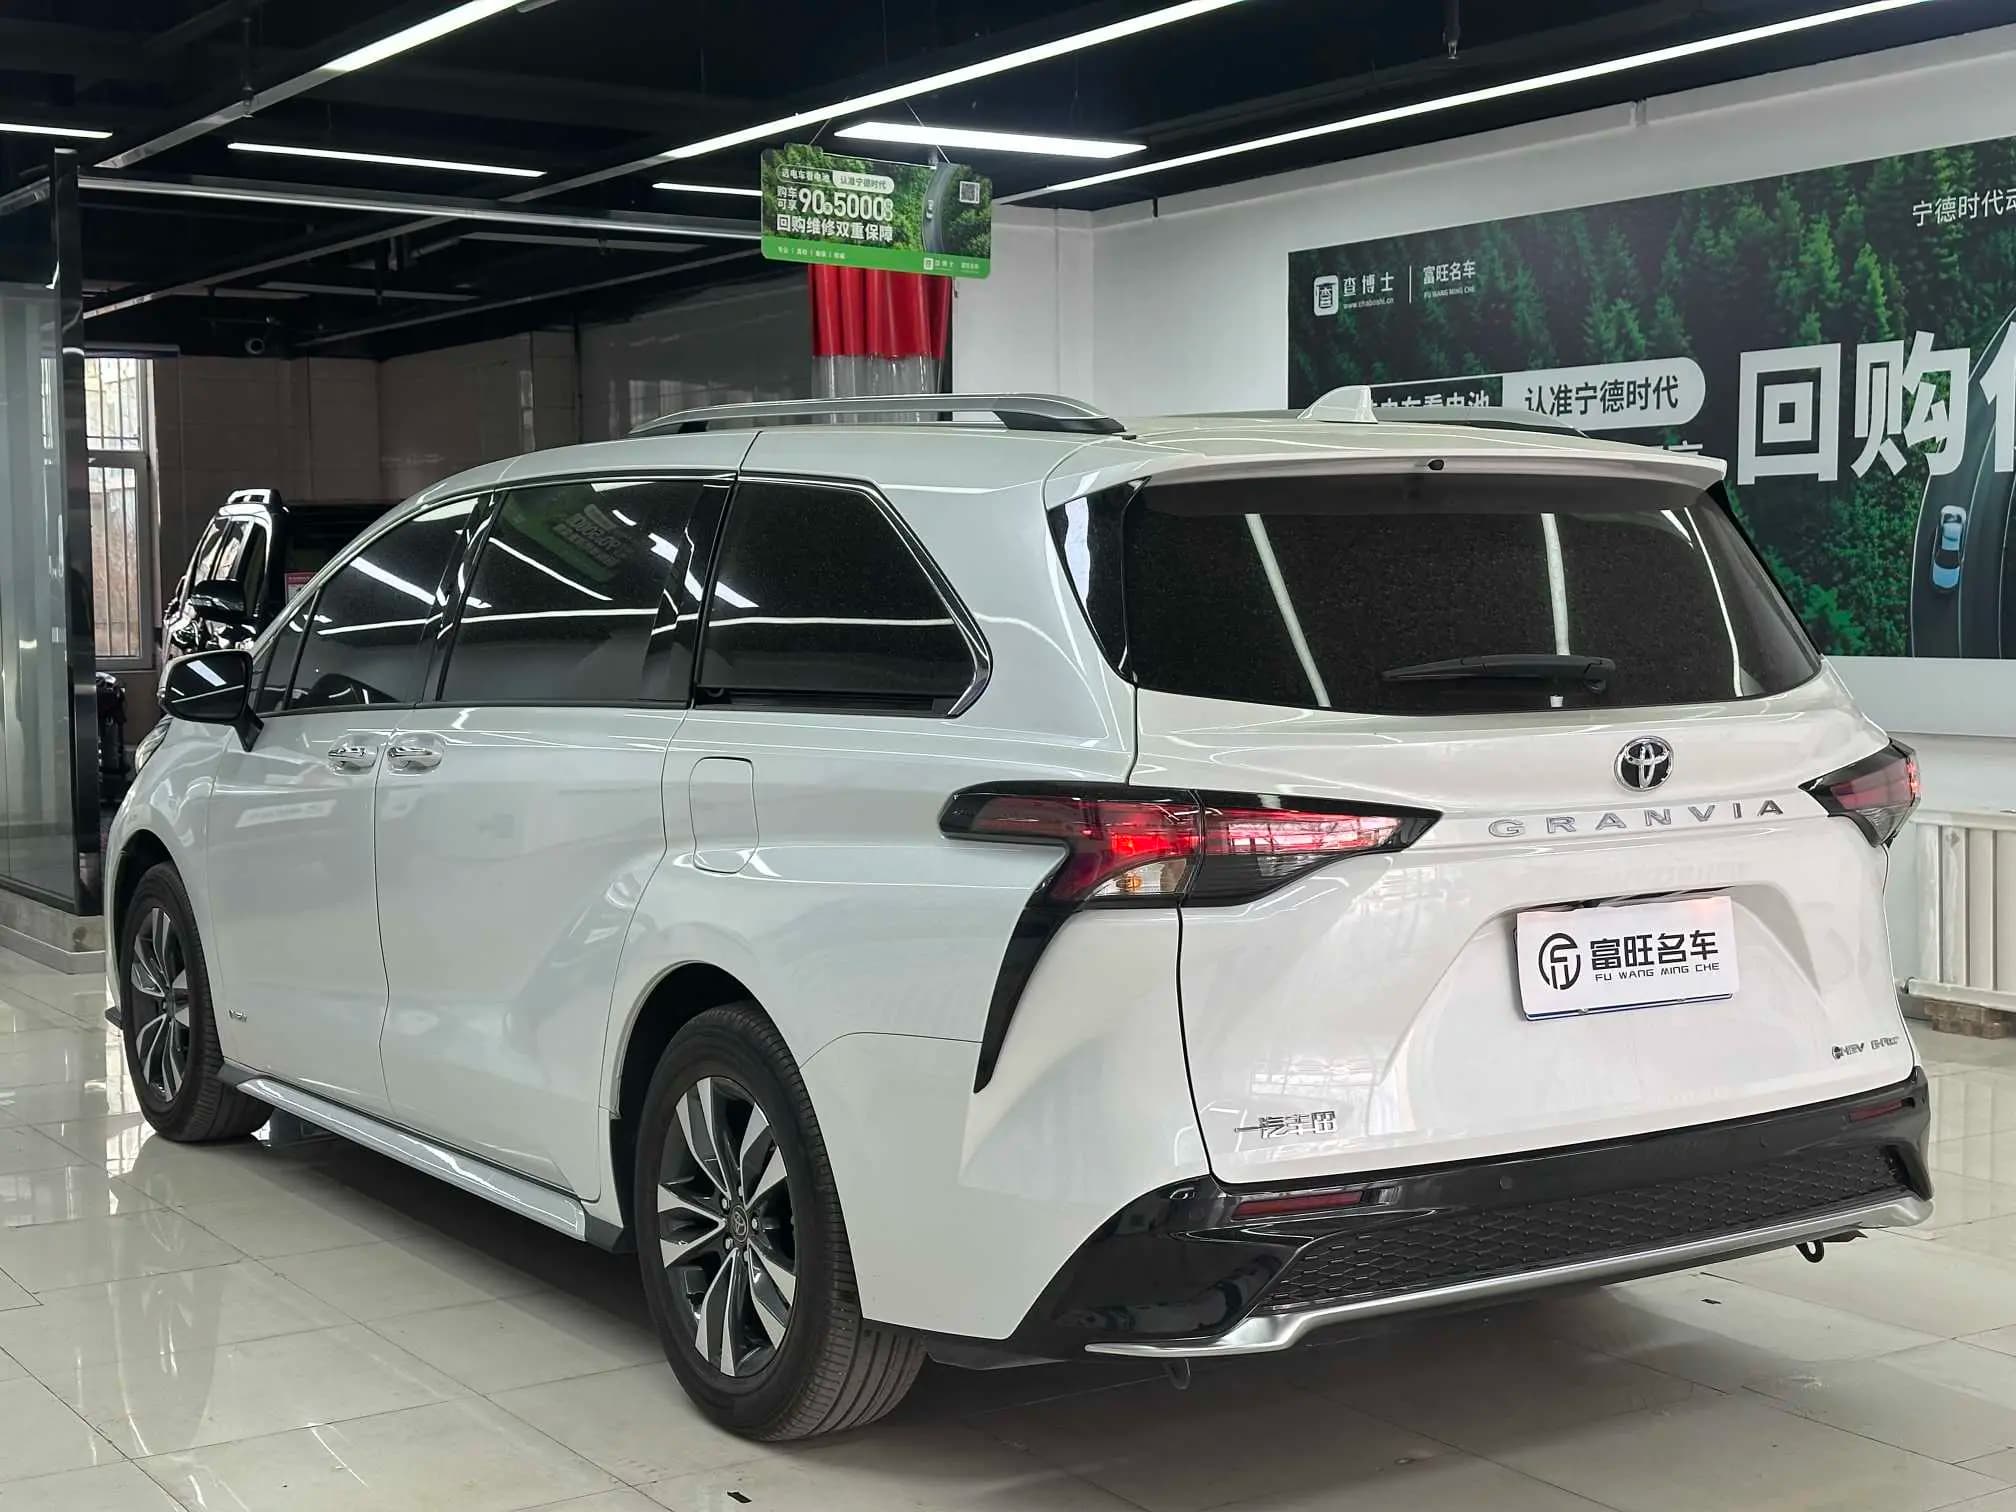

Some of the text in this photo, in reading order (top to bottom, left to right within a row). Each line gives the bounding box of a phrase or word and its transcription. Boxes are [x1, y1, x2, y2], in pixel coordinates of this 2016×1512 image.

[777, 213, 894, 243] 回购维修双重保障
[1343, 271, 1395, 297] 查博士
[1423, 259, 1477, 285] 富旺名车
[1524, 375, 1680, 418] 认准宁德时代
[1488, 799, 1784, 838] GRANVIA
[1590, 929, 1719, 971] 富旺名车
[1595, 962, 1721, 982] FU WANG MING CHE
